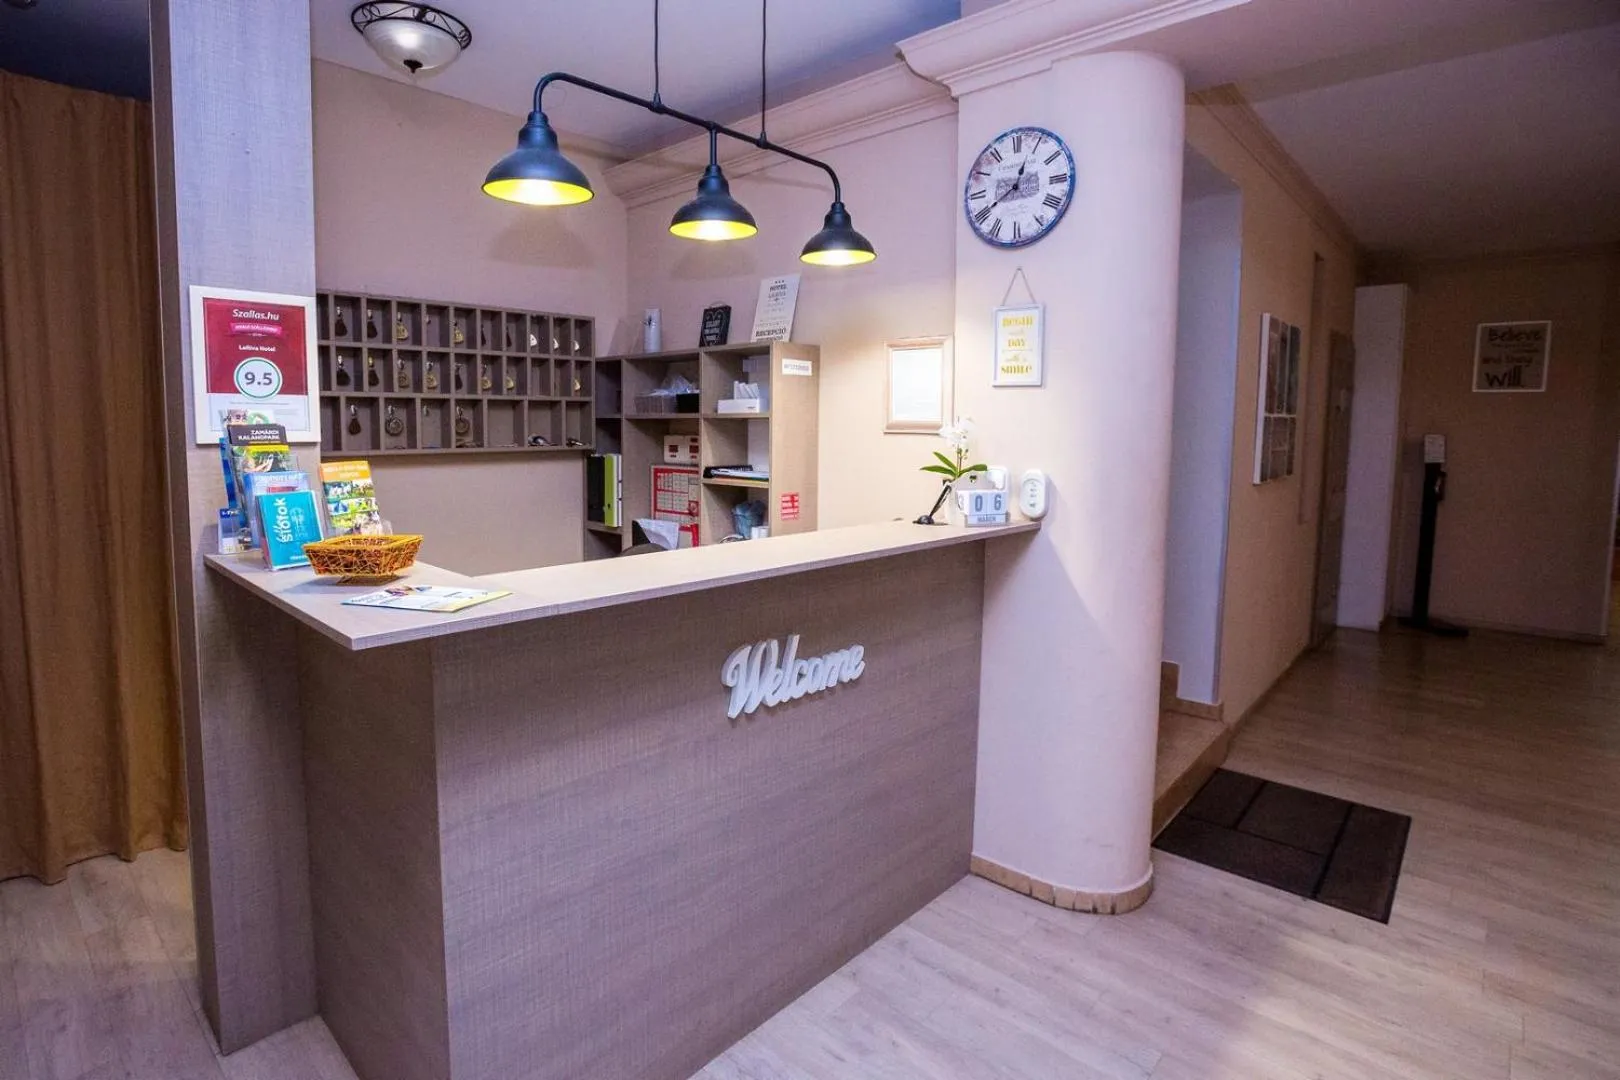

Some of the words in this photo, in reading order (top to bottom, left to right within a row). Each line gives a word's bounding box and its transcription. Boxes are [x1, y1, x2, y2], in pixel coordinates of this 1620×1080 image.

[232, 308, 280, 321] Szallas.hu
[244, 371, 273, 386] 9.5
[993, 494, 1002, 511] 6
[721, 634, 866, 719] Welcome
